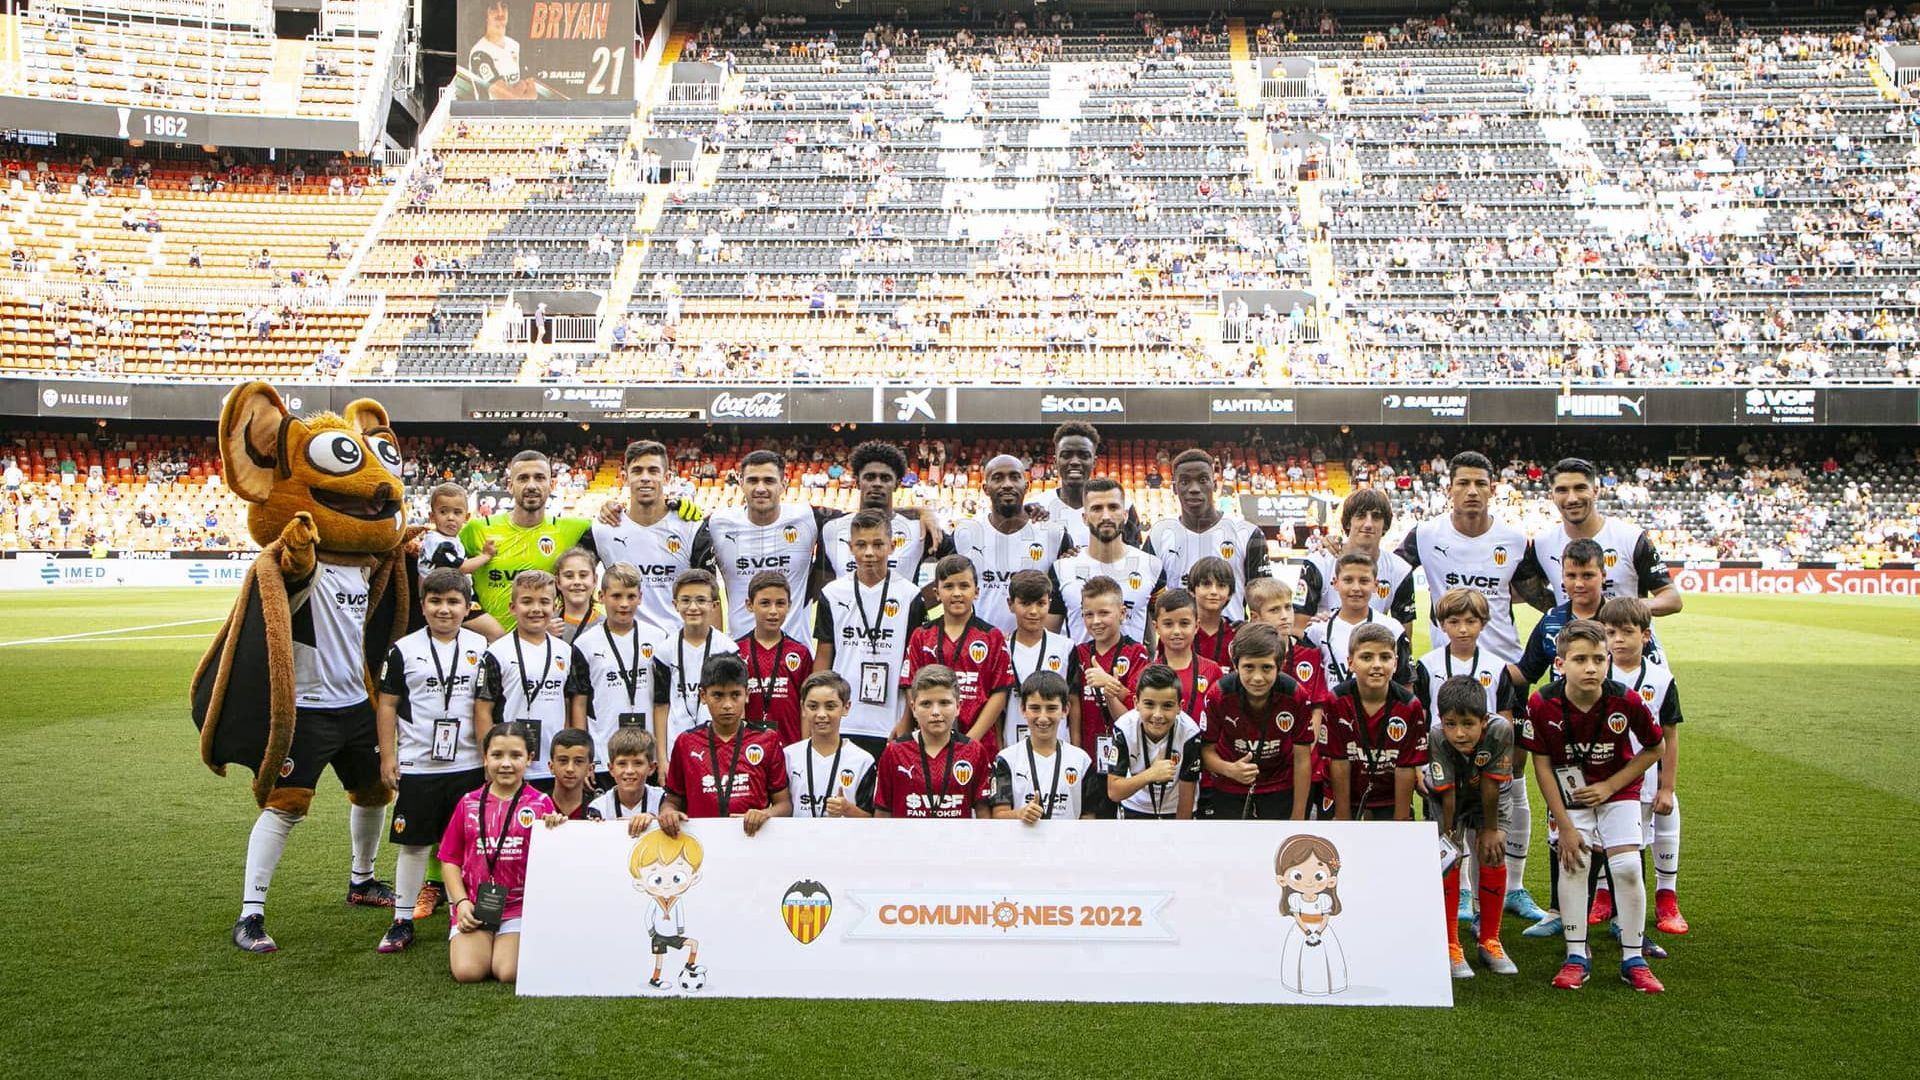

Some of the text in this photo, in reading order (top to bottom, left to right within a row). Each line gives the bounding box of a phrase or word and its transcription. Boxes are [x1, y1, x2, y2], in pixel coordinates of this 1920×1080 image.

[529, 2, 611, 40] BRYAN
[587, 46, 626, 95] 21
[143, 114, 188, 138] 1962
[563, 389, 624, 400] SAILUN
[590, 400, 622, 408] TYRE
[1041, 394, 1124, 412] ŠKODA
[1213, 399, 1294, 412] SAMTRADE
[1403, 395, 1467, 408] SAILUN
[1431, 408, 1465, 416] TYRE
[1746, 406, 1815, 414] FAN TOKEN
[736, 555, 791, 570] $VCF
[65, 567, 106, 578] IMED
[214, 568, 250, 579] IME
[488, 569, 524, 583] $V
[638, 564, 677, 575] VCF
[982, 570, 1015, 583] $V
[1446, 573, 1500, 588] $VCF
[1707, 570, 1794, 593] LaLiga
[335, 592, 368, 605] $VC
[843, 626, 895, 641] $VCF
[1363, 761, 1397, 769] TKEN
[936, 809, 962, 817] OKEN
[879, 899, 1143, 930] COMUNIONES 2022
